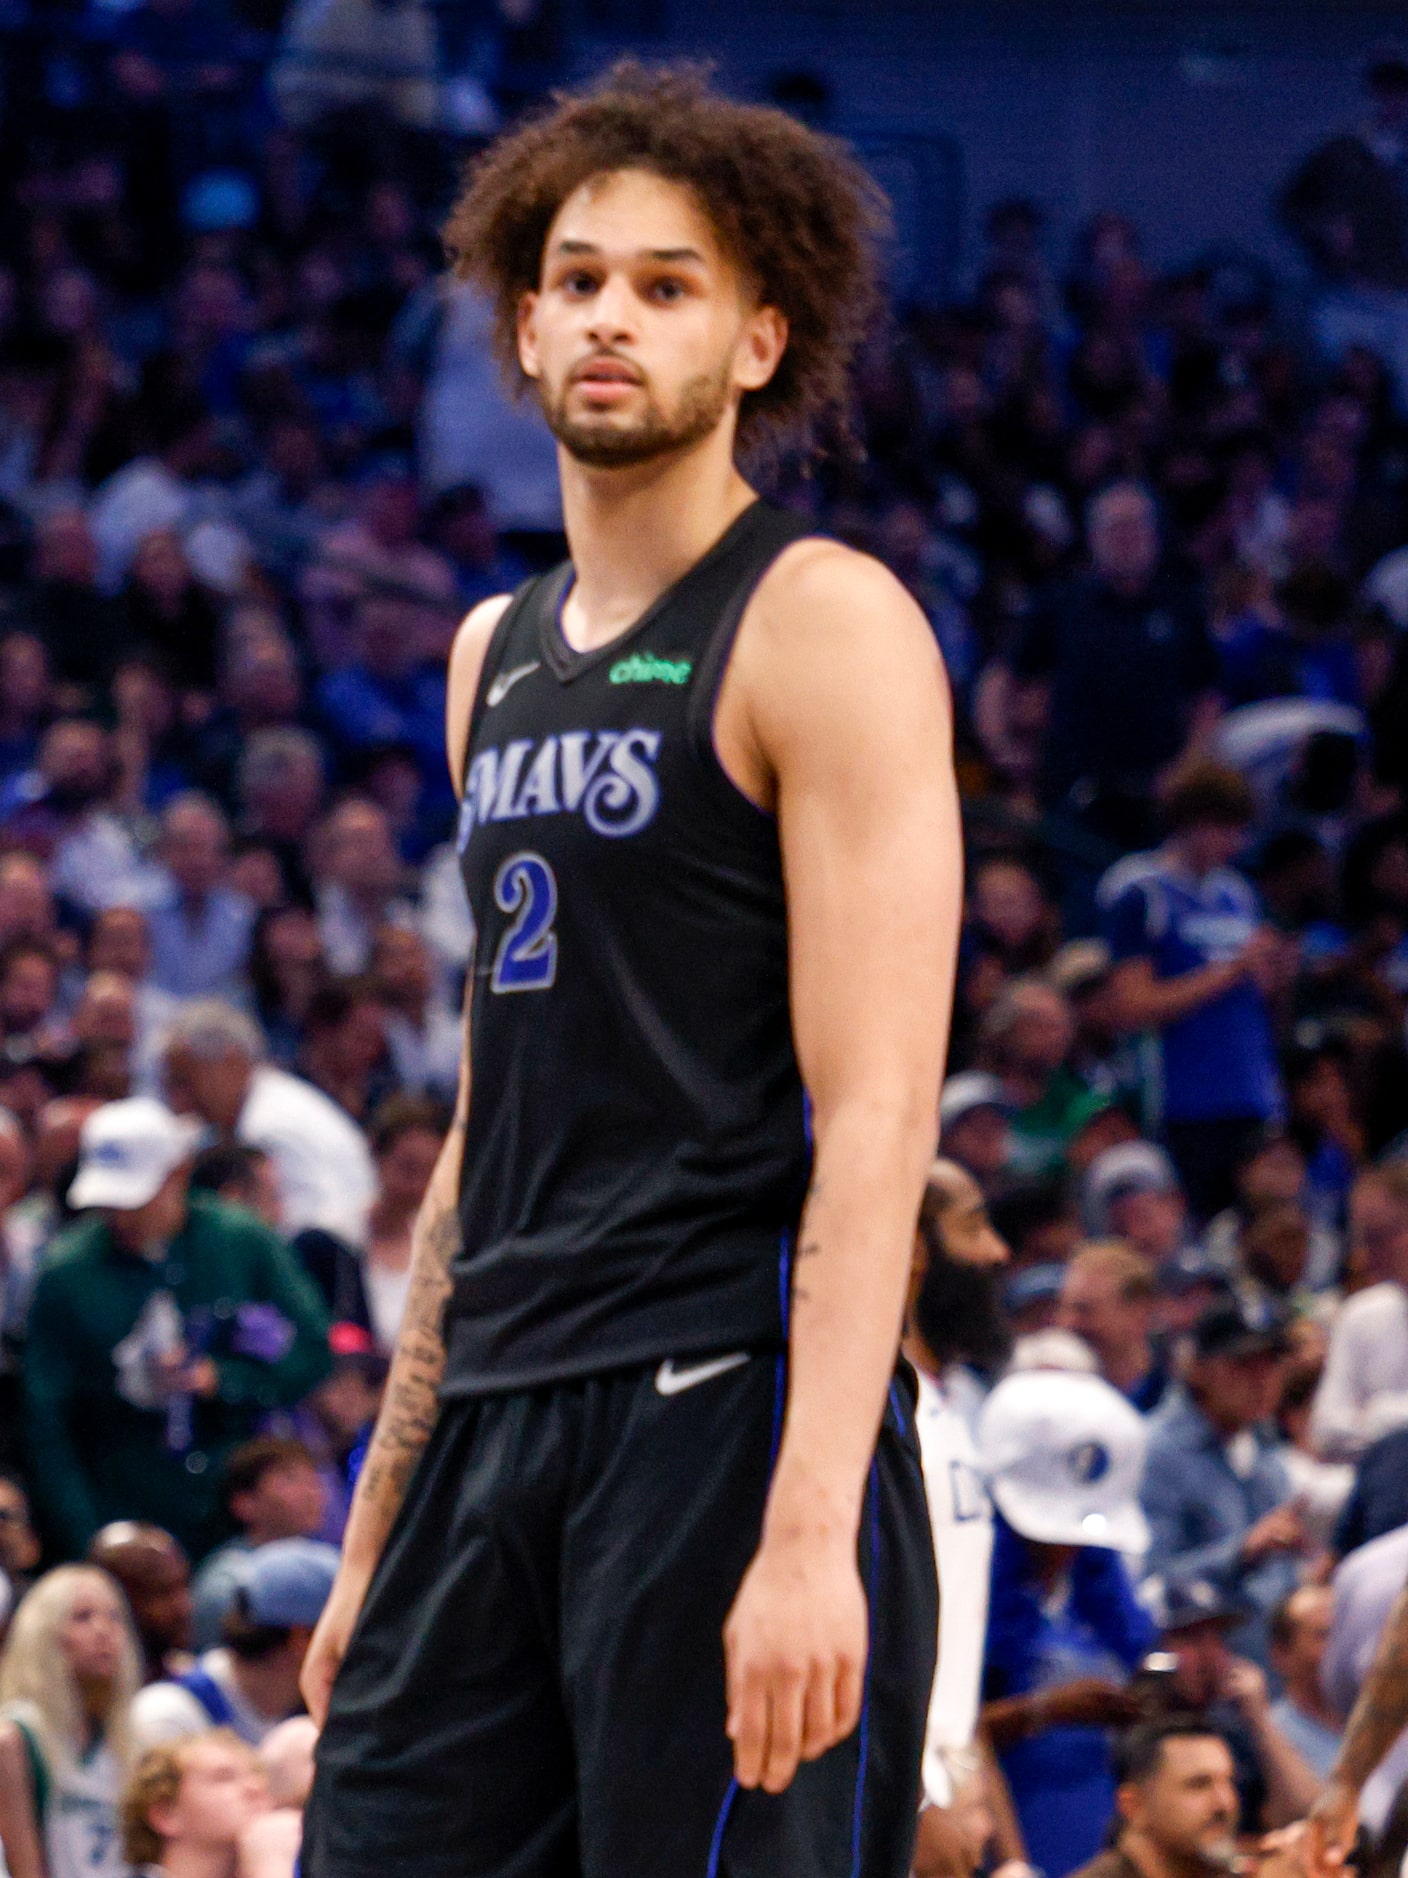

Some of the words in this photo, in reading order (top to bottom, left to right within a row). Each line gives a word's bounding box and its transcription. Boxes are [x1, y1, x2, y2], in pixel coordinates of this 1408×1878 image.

[608, 652, 691, 685] chime
[455, 728, 662, 854] MAVS
[490, 852, 559, 994] 2
